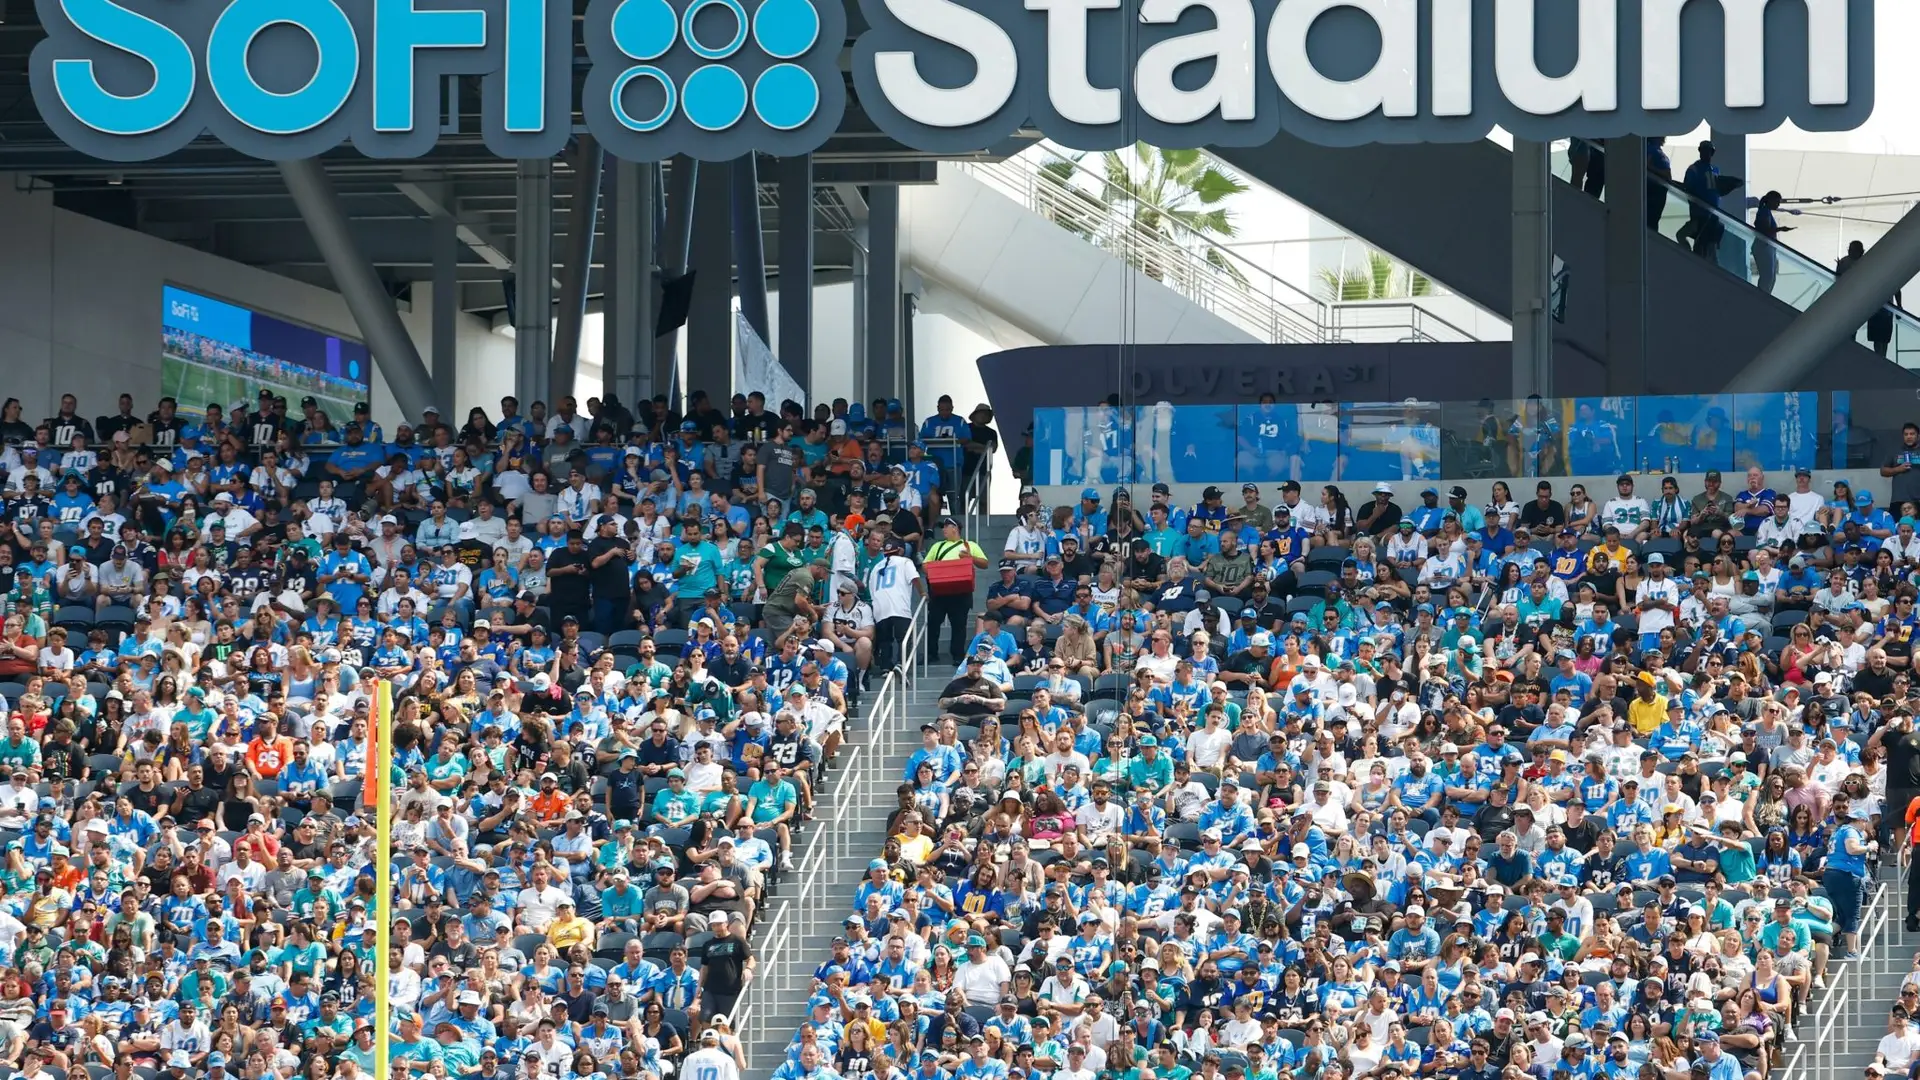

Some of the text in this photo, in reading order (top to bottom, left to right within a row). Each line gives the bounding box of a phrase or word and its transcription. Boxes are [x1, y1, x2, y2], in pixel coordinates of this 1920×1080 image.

[873, 0, 1849, 127] Stadium
[171, 300, 190, 319] SoFi
[1131, 366, 1377, 396] OLVERA ST
[55, 426, 75, 445] 10
[254, 425, 272, 443] 10
[1259, 423, 1278, 437] 13
[72, 458, 87, 467] 10
[1156, 541, 1161, 556] 1
[1554, 557, 1576, 574] 10
[772, 669, 792, 690] 12
[772, 743, 797, 763] 33
[1592, 870, 1611, 887] 33
[1768, 863, 1790, 882] 30
[963, 891, 986, 912] 10
[171, 907, 194, 922] 70
[177, 1038, 197, 1052] 10
